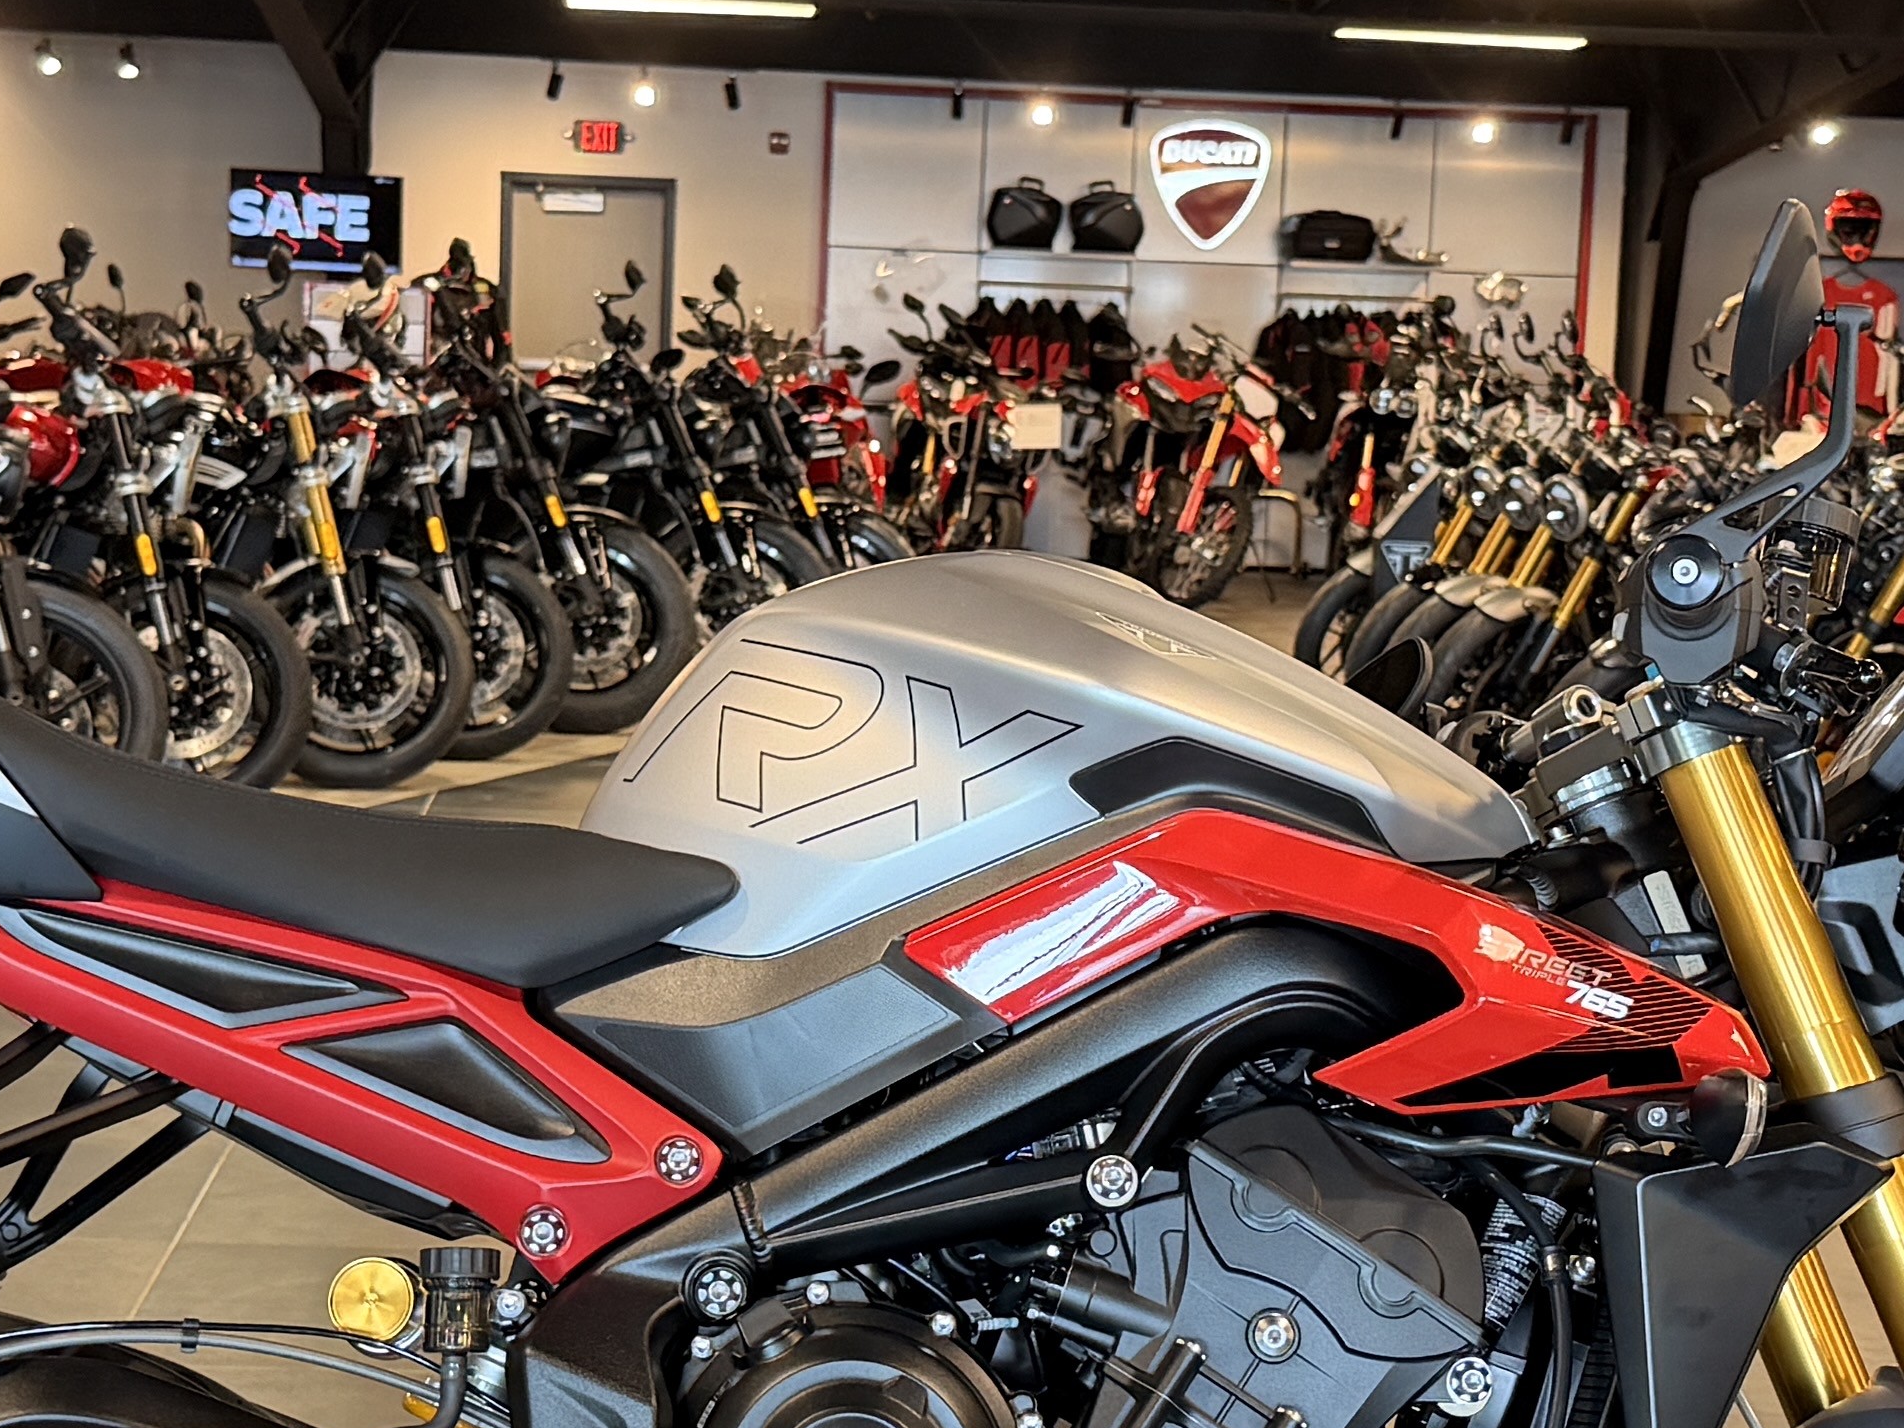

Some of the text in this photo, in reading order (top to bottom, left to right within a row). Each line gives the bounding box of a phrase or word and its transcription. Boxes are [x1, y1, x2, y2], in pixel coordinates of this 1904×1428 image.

[581, 122, 618, 151] EXIT
[1161, 139, 1258, 165] DUCATI
[228, 188, 370, 242] SAFE
[623, 639, 1084, 844] RX
[1473, 934, 1612, 986] STREET
[1511, 962, 1568, 986] TRIPLE
[1565, 979, 1635, 1019] 765
